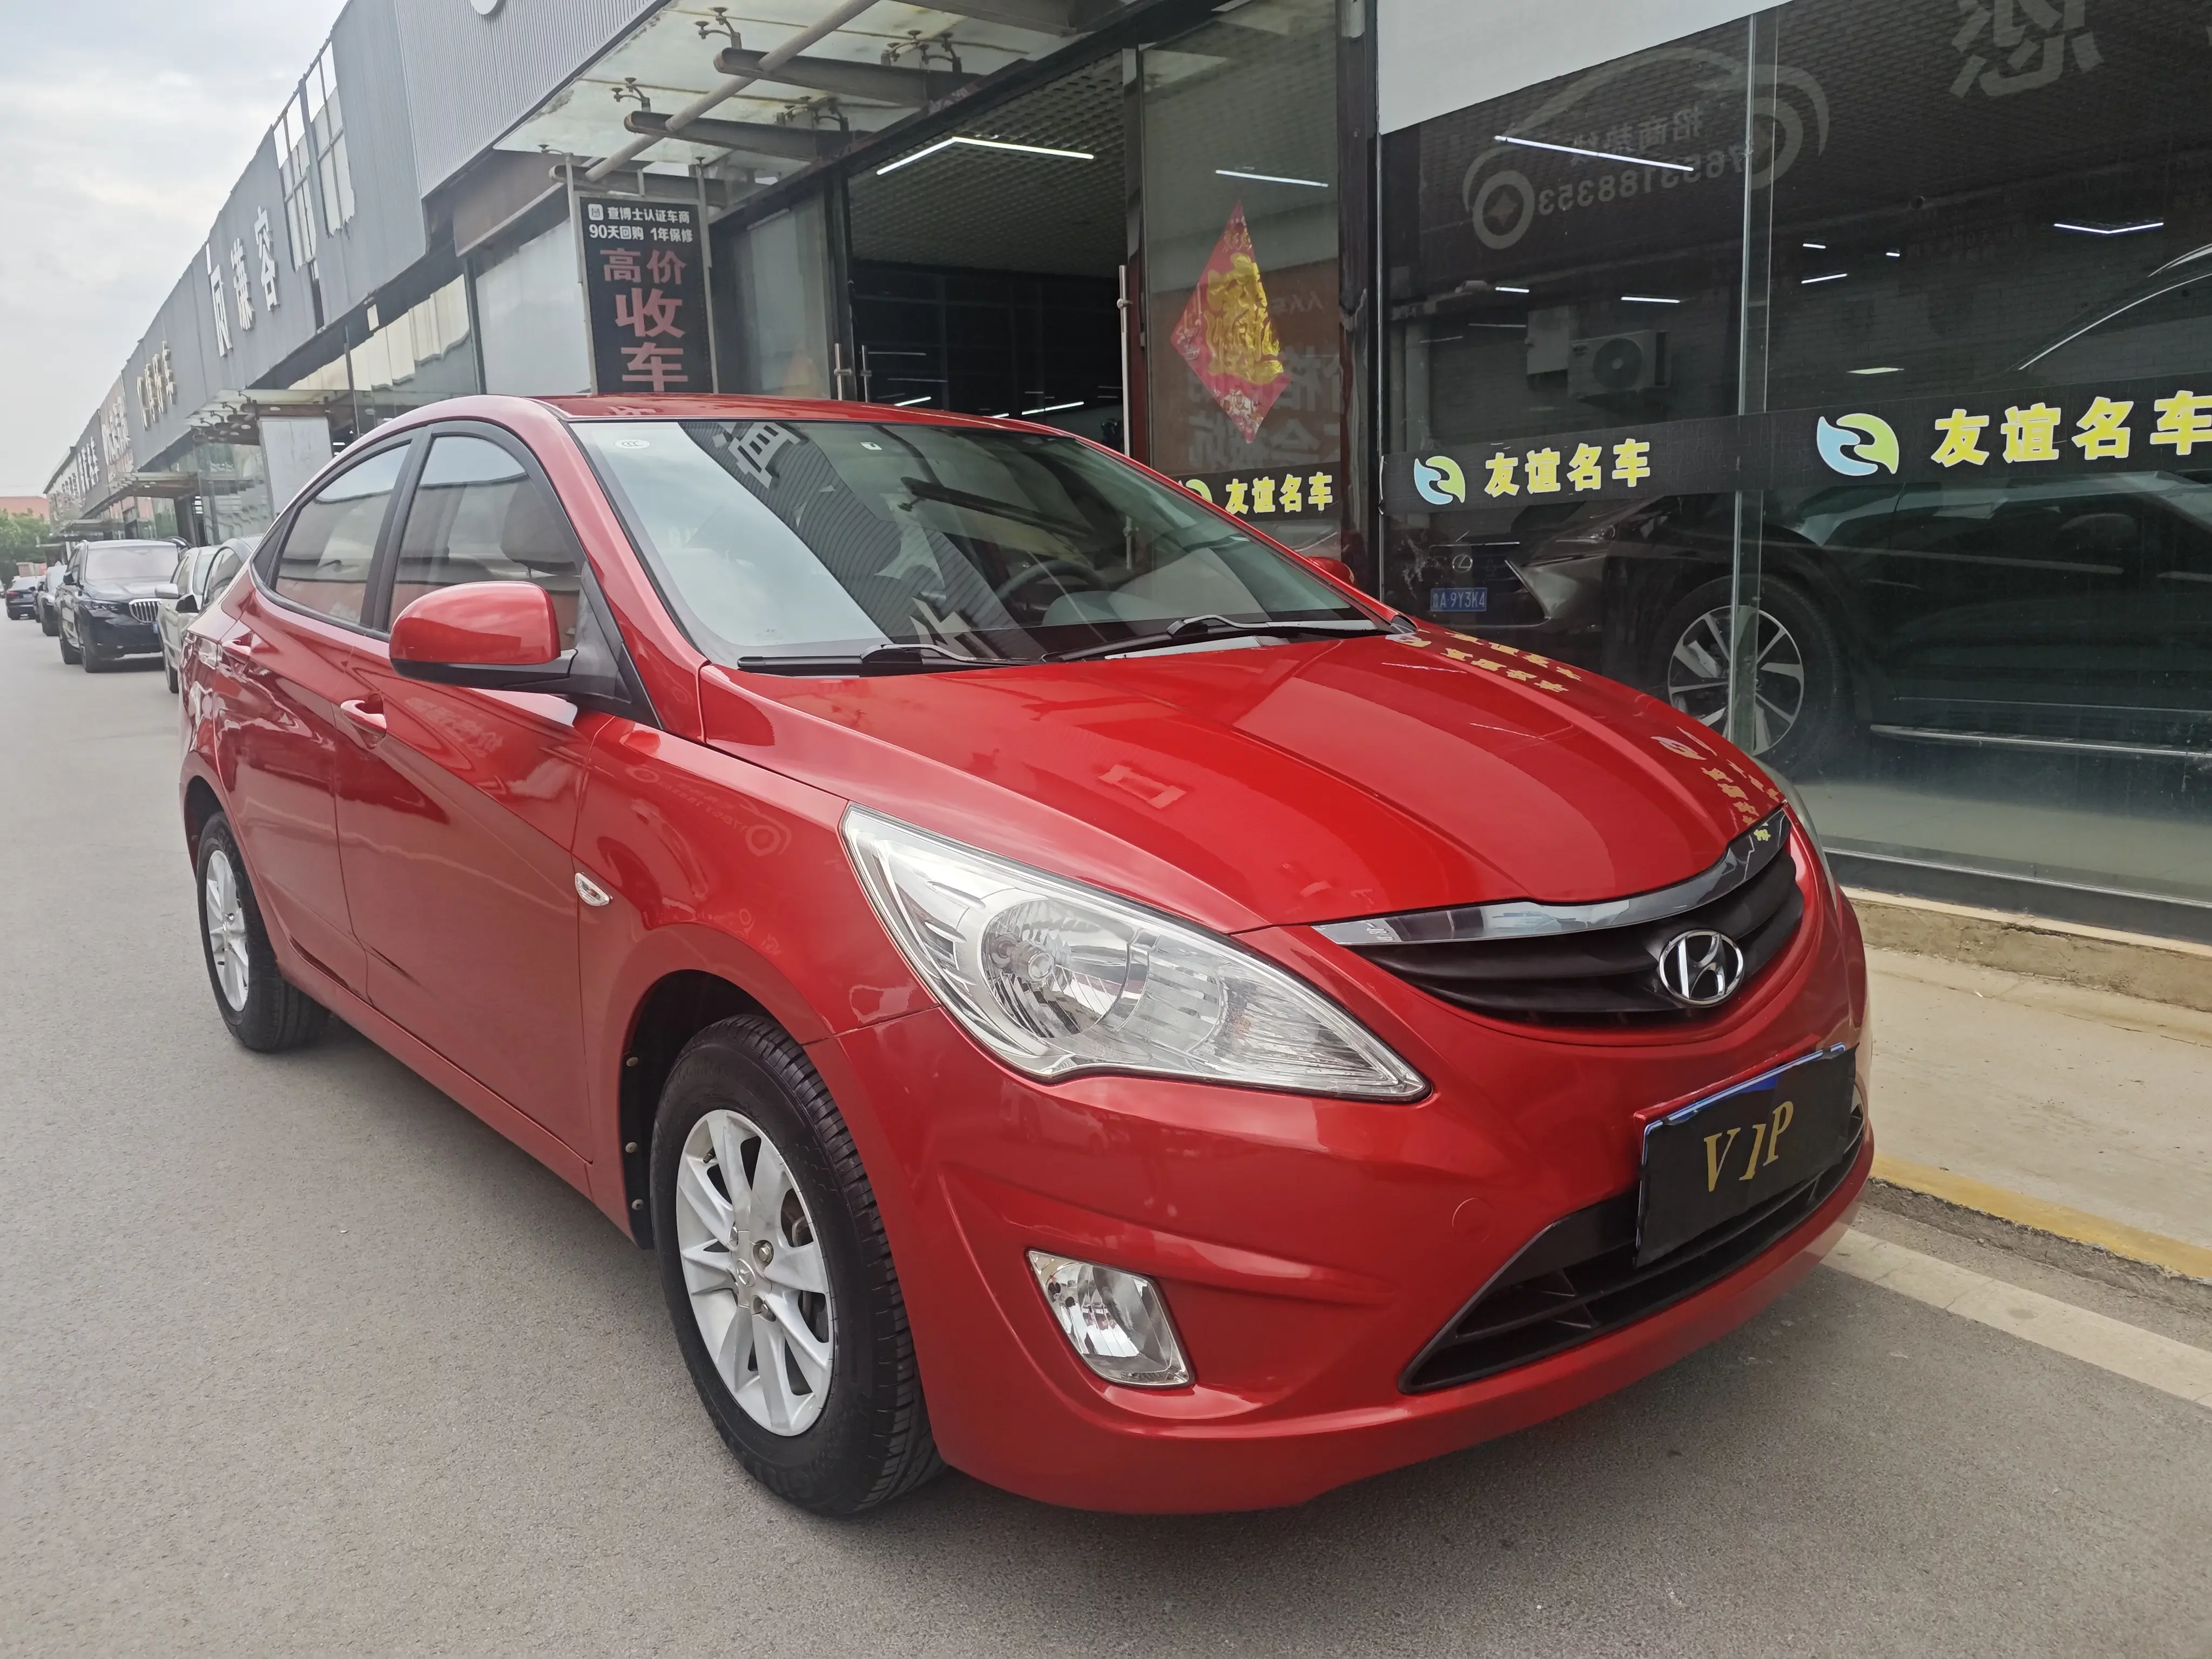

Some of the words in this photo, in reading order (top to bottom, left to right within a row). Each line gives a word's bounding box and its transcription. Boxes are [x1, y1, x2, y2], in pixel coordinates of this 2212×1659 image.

[589, 224, 644, 241] 90天回购
[650, 227, 693, 243] 1年保修
[600, 247, 687, 285] 高价
[1931, 390, 2212, 468] 友谊名车
[1225, 471, 1332, 515] 友谊名车
[1484, 438, 1651, 497] 友谊名车
[1703, 1101, 1793, 1192] VIP
